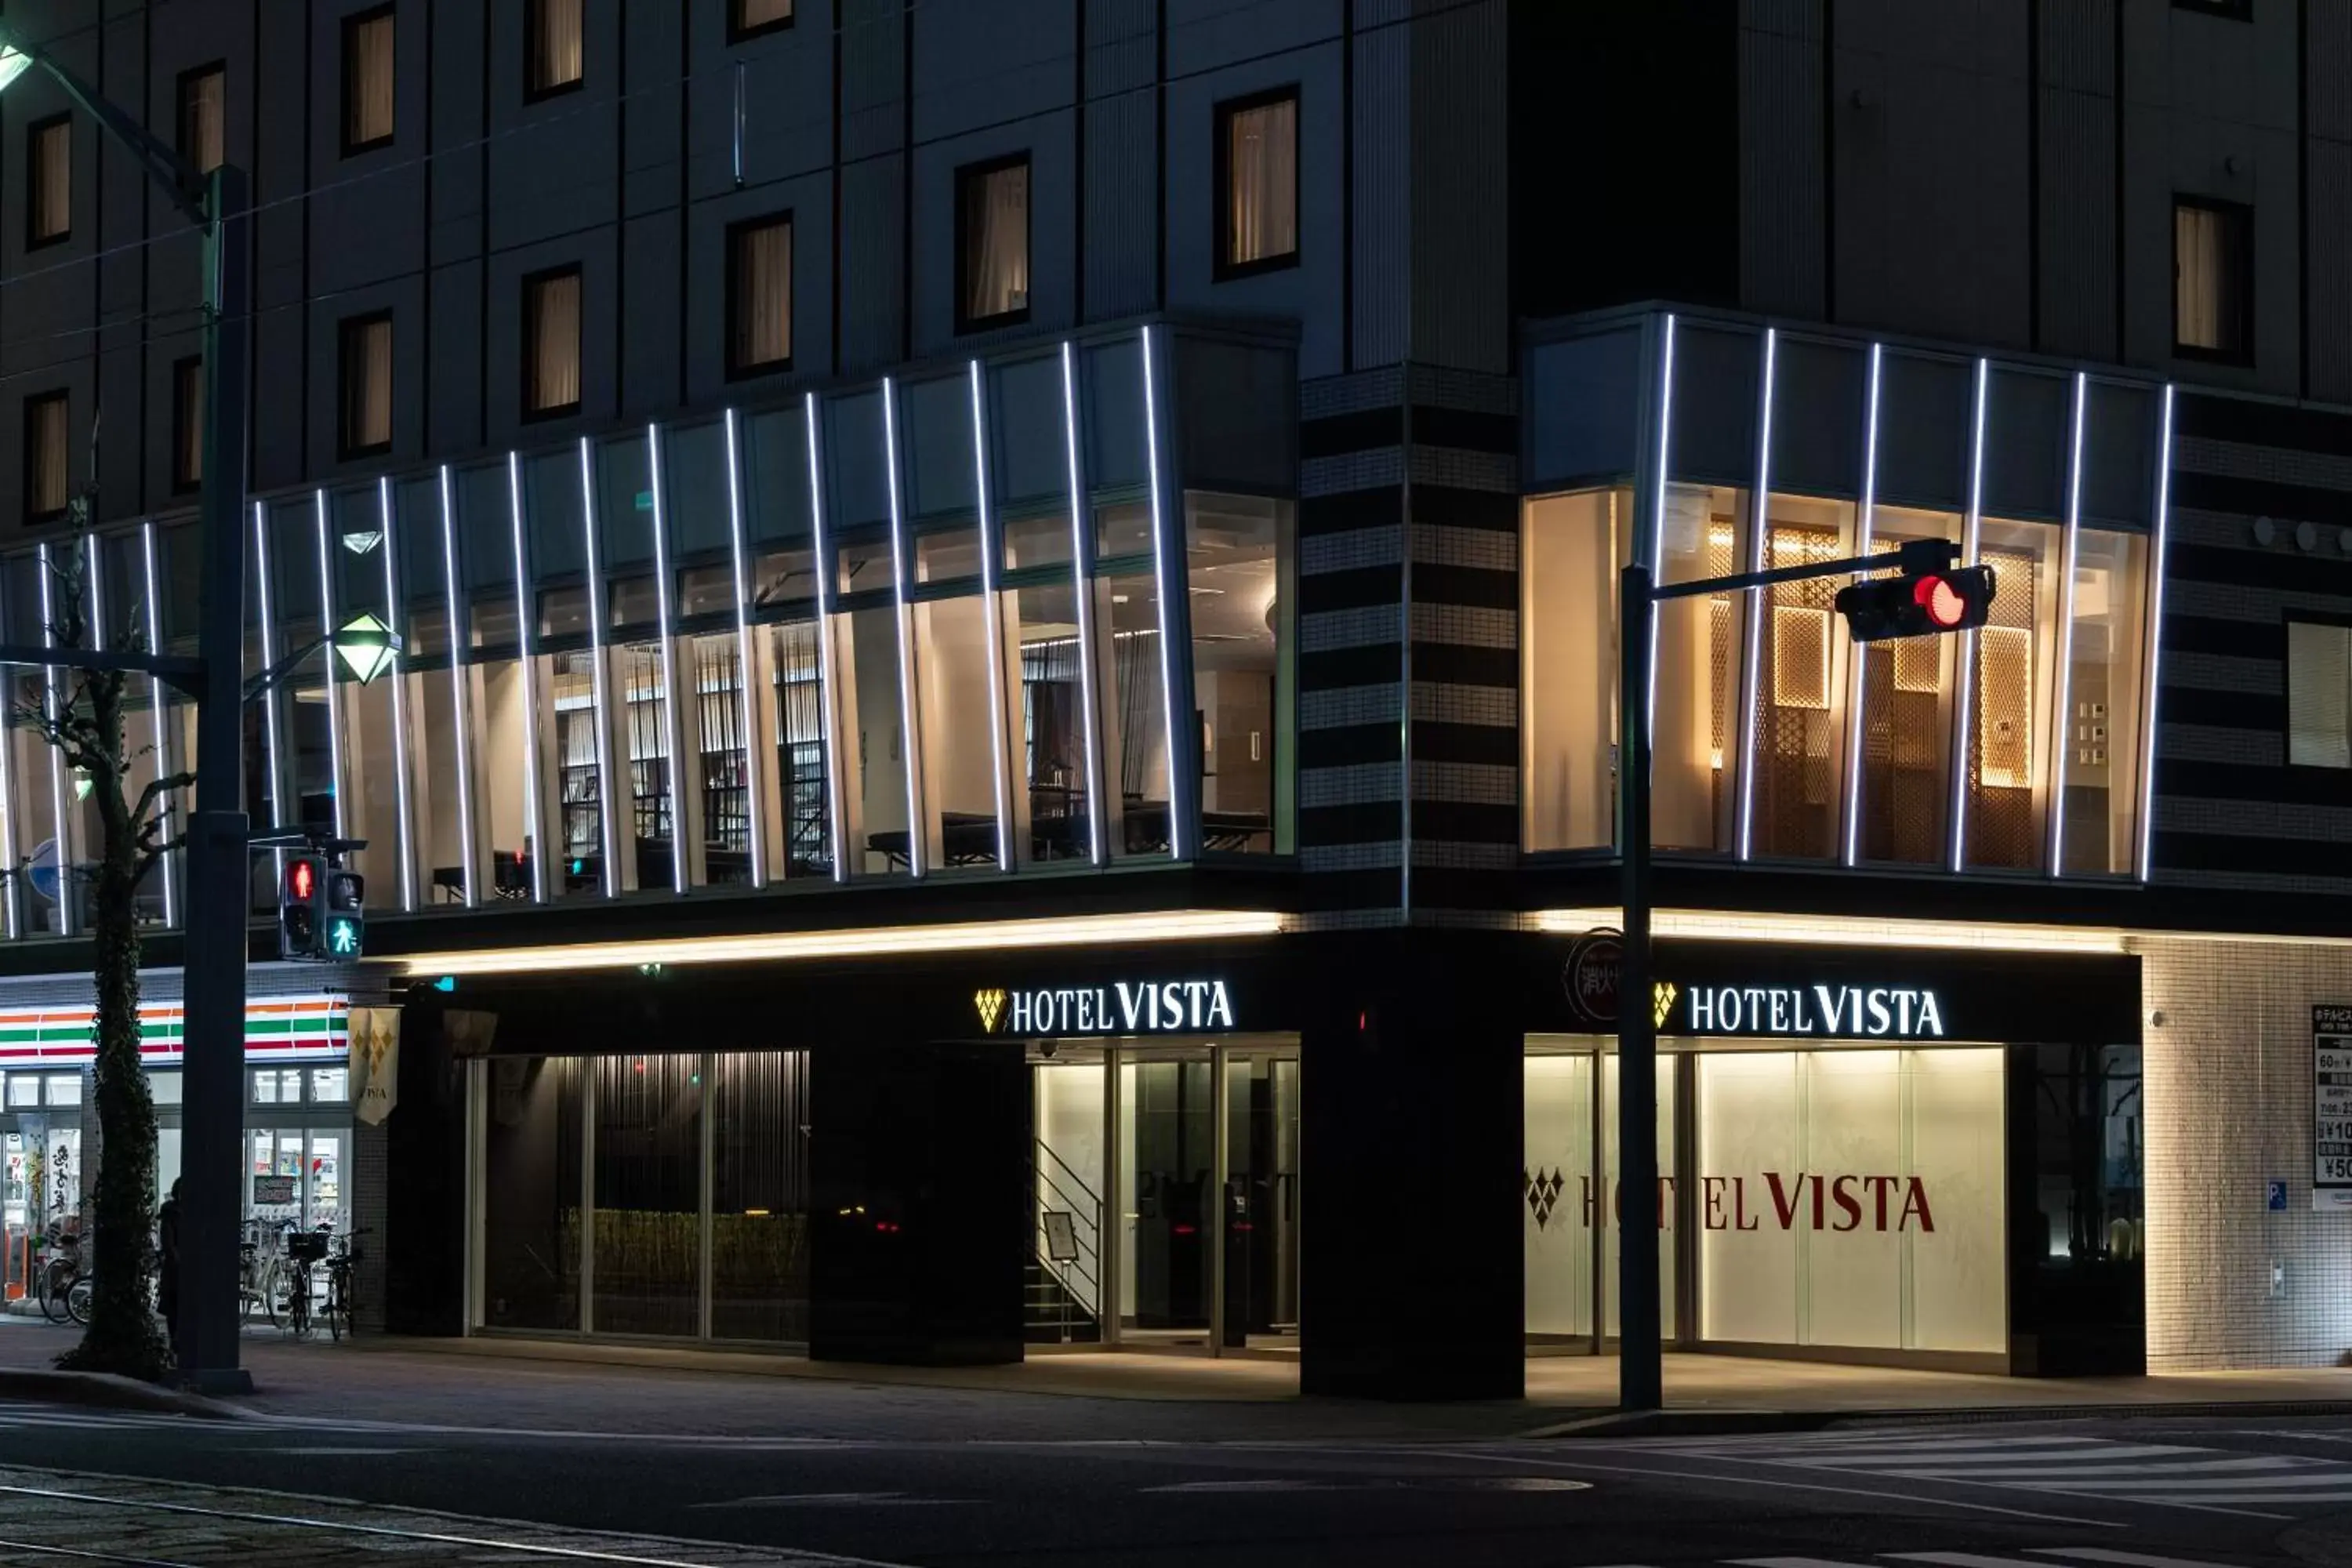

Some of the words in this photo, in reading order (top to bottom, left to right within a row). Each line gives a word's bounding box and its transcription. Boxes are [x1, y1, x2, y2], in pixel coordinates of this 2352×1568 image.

[1012, 988, 1114, 1033] HOTEL
[1115, 980, 1233, 1030] VISTA
[1690, 986, 1813, 1032] HOTEL
[1813, 985, 1944, 1036] VISTA
[1581, 1175, 1759, 1231] HTEL
[1762, 1172, 1935, 1232] VISTA
[2270, 1183, 2278, 1201] P
